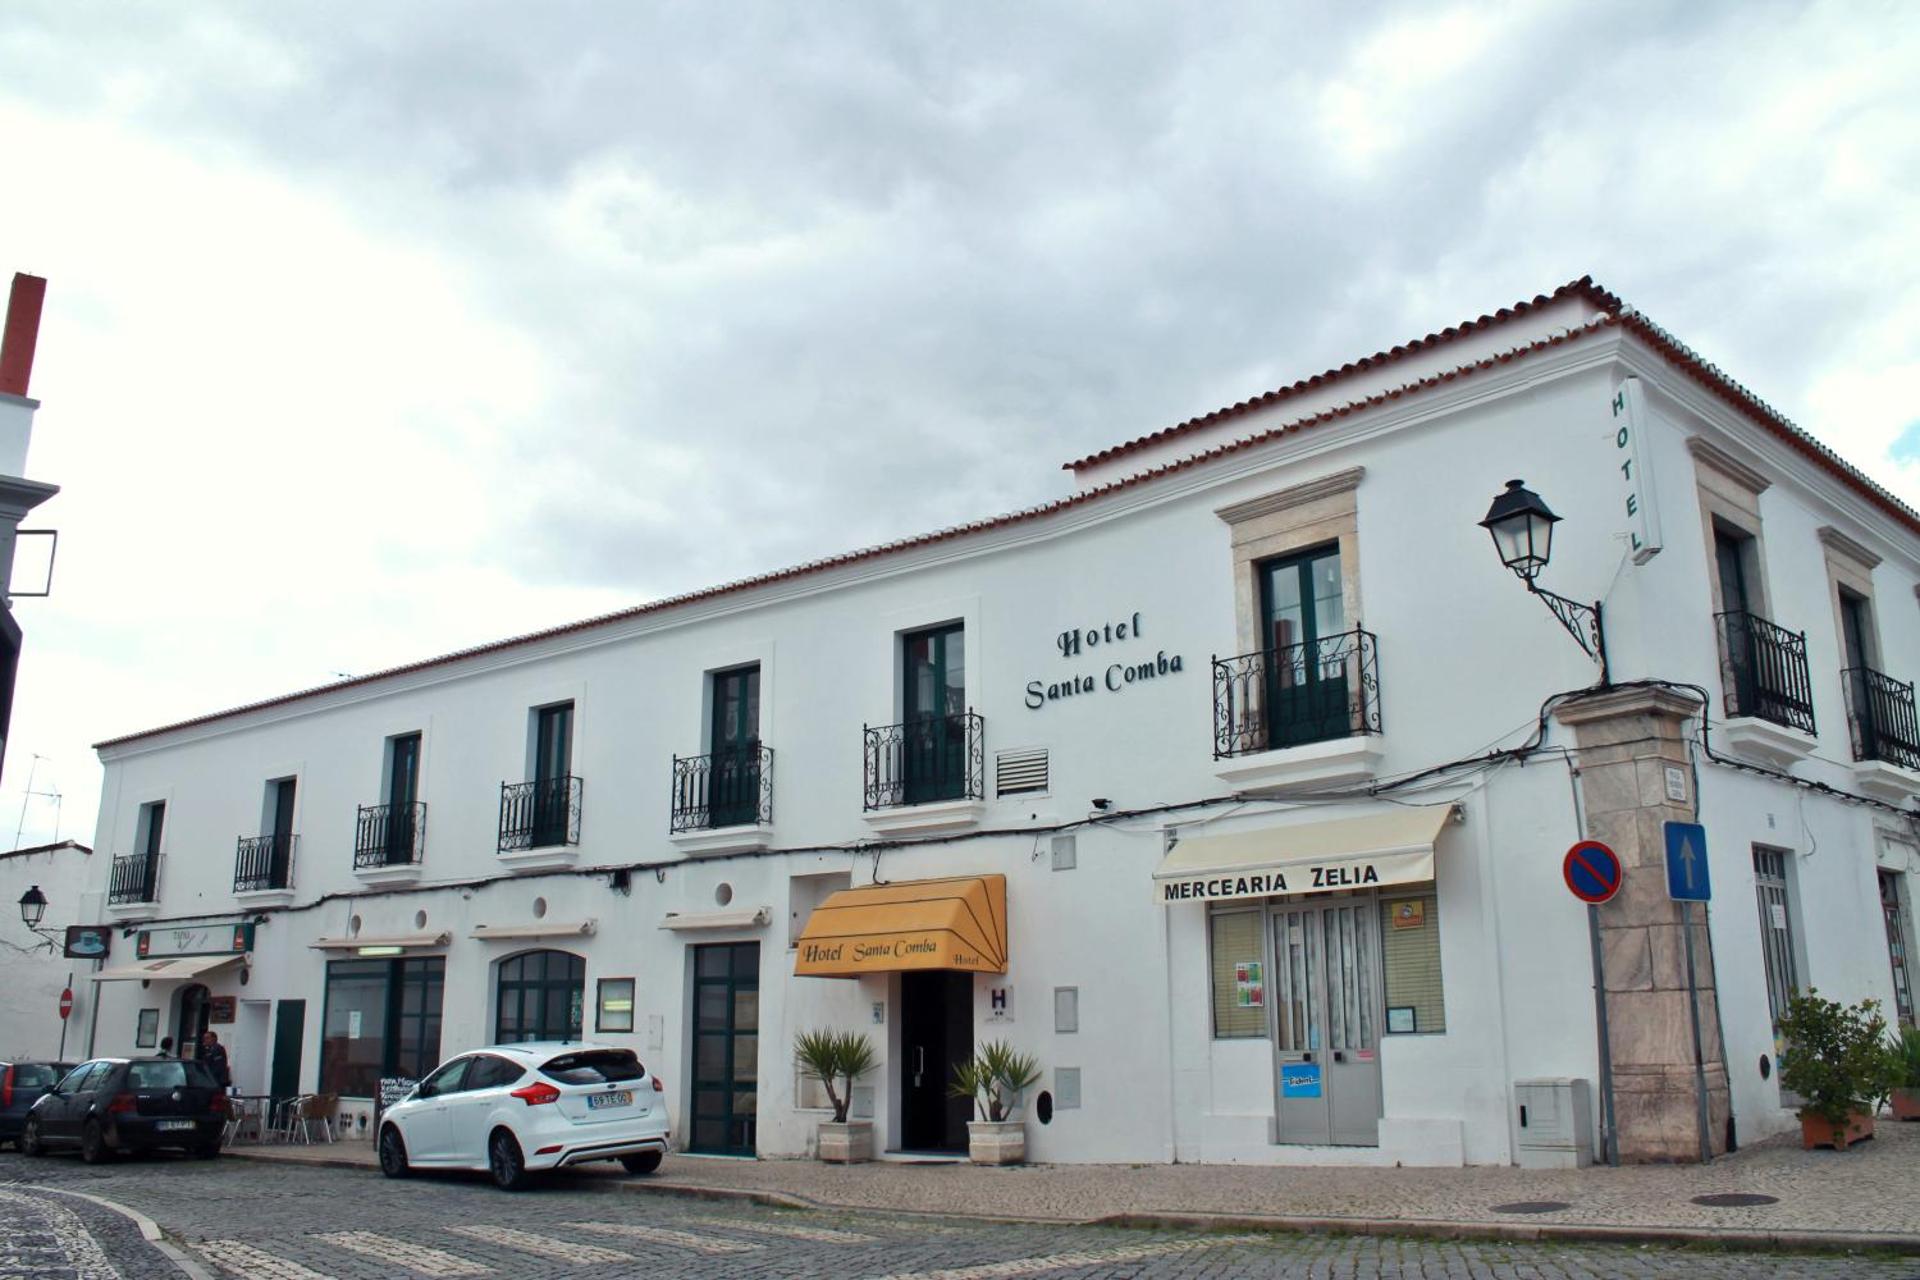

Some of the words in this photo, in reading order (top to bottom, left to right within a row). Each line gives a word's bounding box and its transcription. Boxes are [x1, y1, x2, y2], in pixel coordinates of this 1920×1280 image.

[1611, 391, 1642, 552] HOTEL
[1057, 611, 1141, 658] Hotel
[1025, 673, 1095, 710] Santa
[1105, 650, 1183, 692] Comba
[1164, 872, 1288, 901] MERCEARIA
[1310, 864, 1379, 888] ZELIA
[804, 943, 844, 963] Hotel
[853, 942, 890, 962] Santa
[894, 938, 937, 958] Comba
[953, 954, 980, 966] Hotel
[991, 988, 1006, 1009] H
